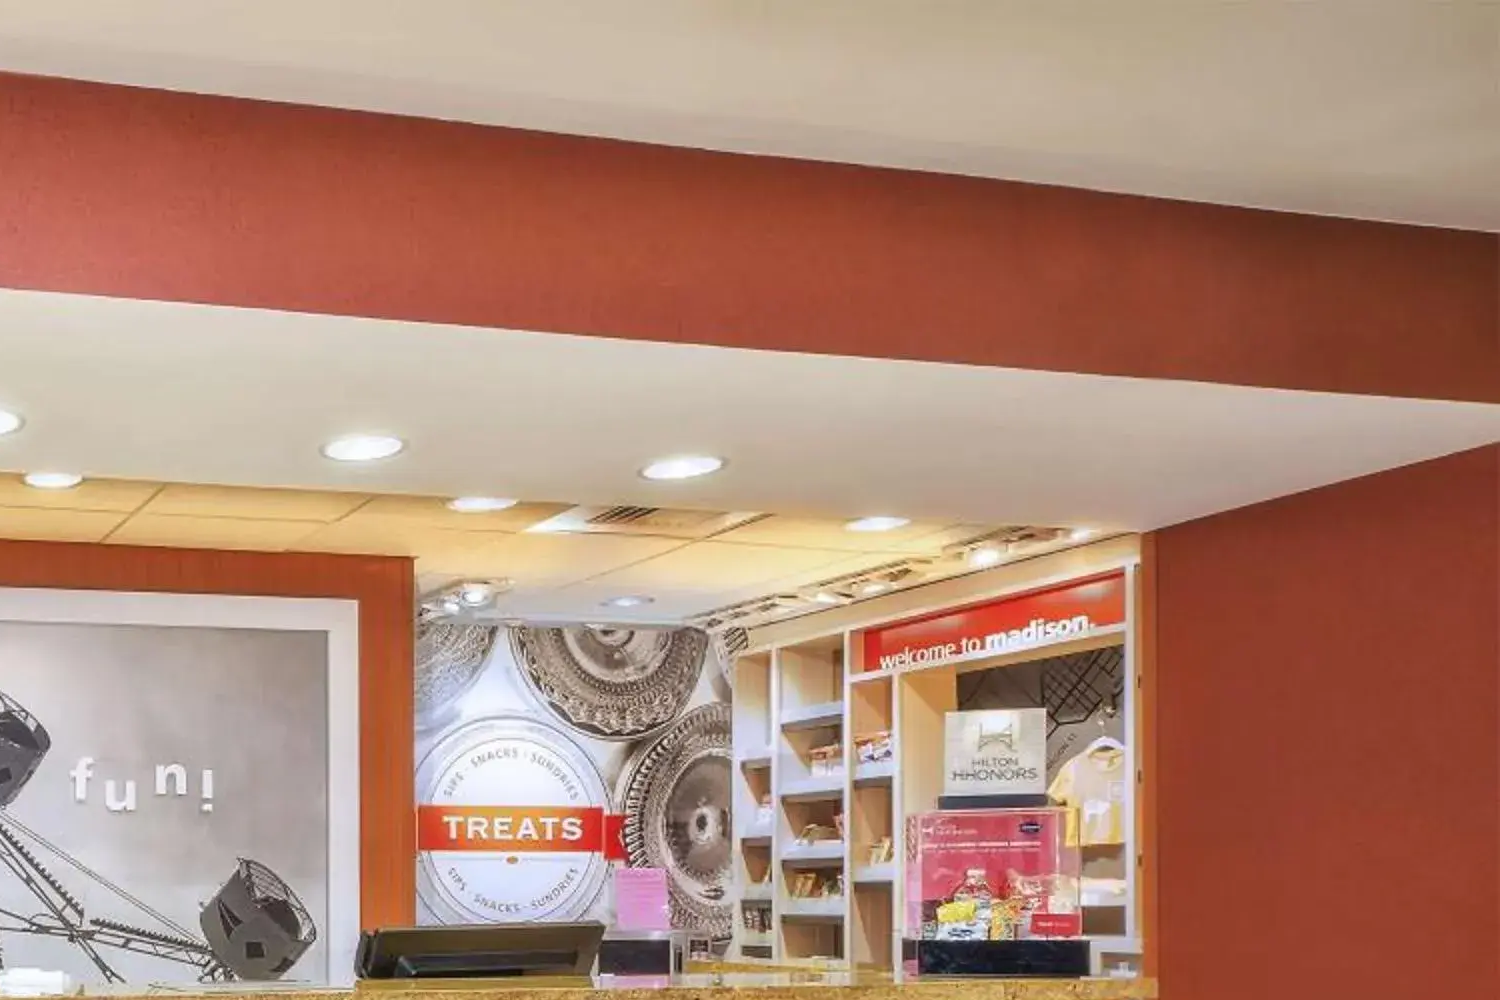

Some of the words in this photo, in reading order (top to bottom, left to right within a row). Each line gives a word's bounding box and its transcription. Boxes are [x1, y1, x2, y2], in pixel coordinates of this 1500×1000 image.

[879, 641, 956, 670] welcome
[959, 637, 981, 655] to
[470, 747, 519, 768] SNACKS
[529, 752, 580, 801] SUNDRIES
[951, 767, 1039, 782] HHONORS
[971, 756, 1019, 768] HILTON
[68, 756, 213, 813] fun!
[442, 814, 583, 841] TREATS
[448, 867, 468, 892] SIPS
[474, 893, 521, 913] SNACKS
[531, 866, 579, 910] SUNDRIES
